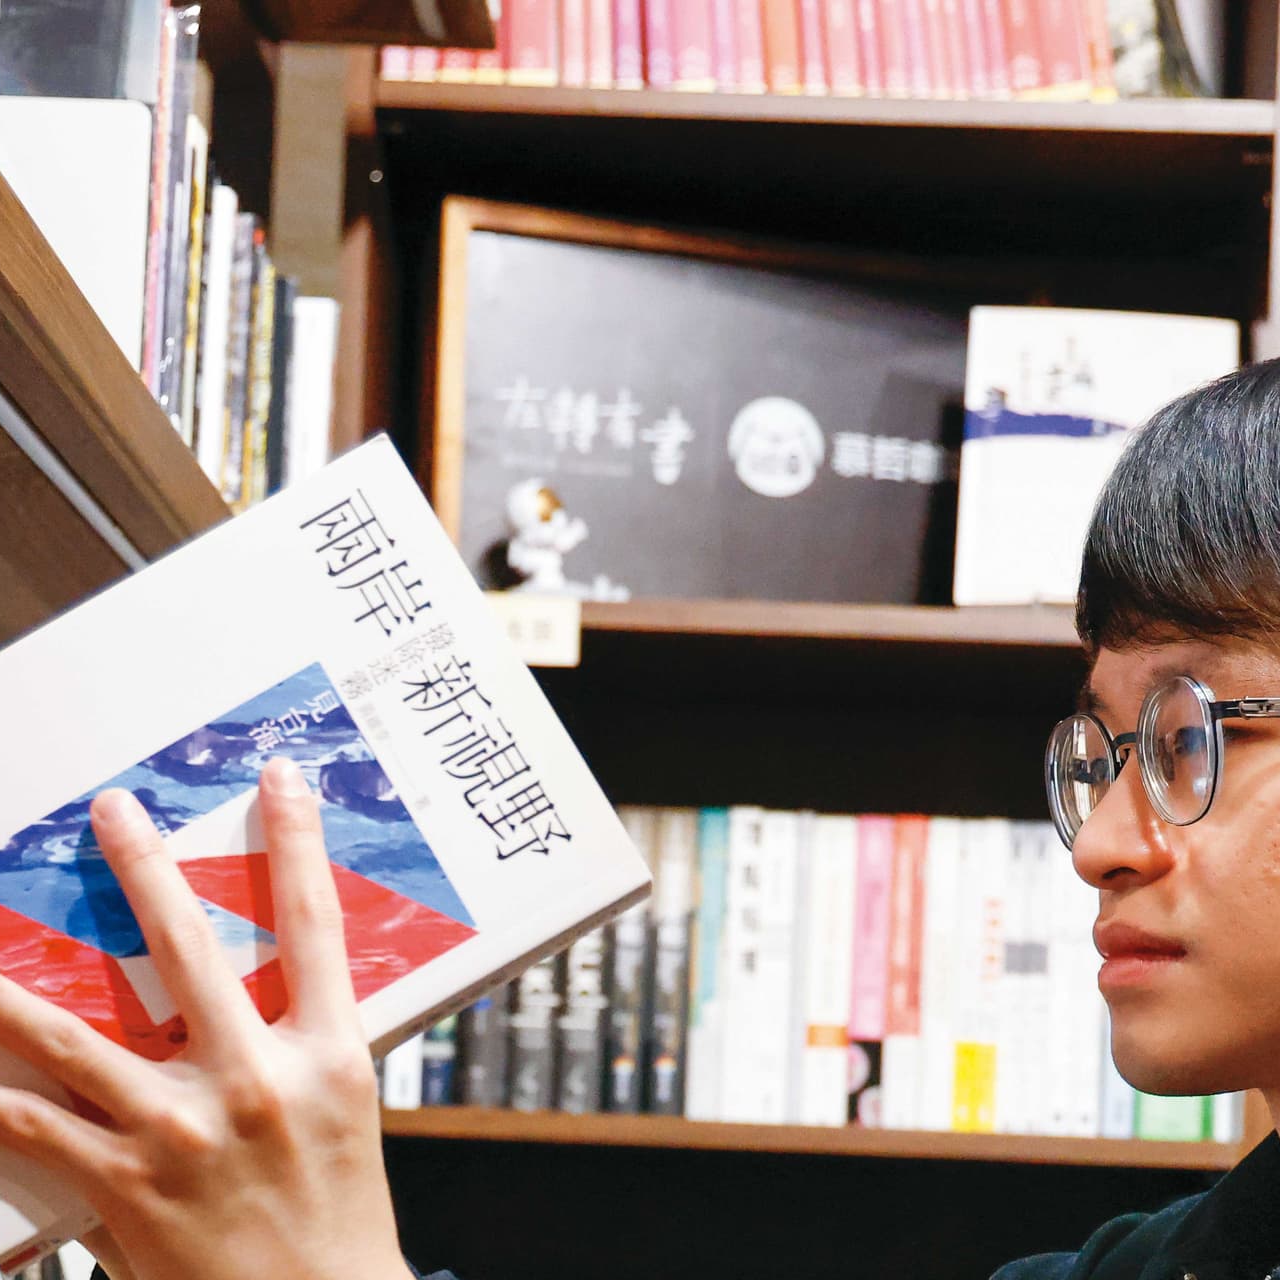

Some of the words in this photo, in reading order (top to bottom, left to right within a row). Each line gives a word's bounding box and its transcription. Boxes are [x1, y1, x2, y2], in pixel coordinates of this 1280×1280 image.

[300, 488, 433, 637] 兩岸
[401, 654, 572, 861] 新視野
